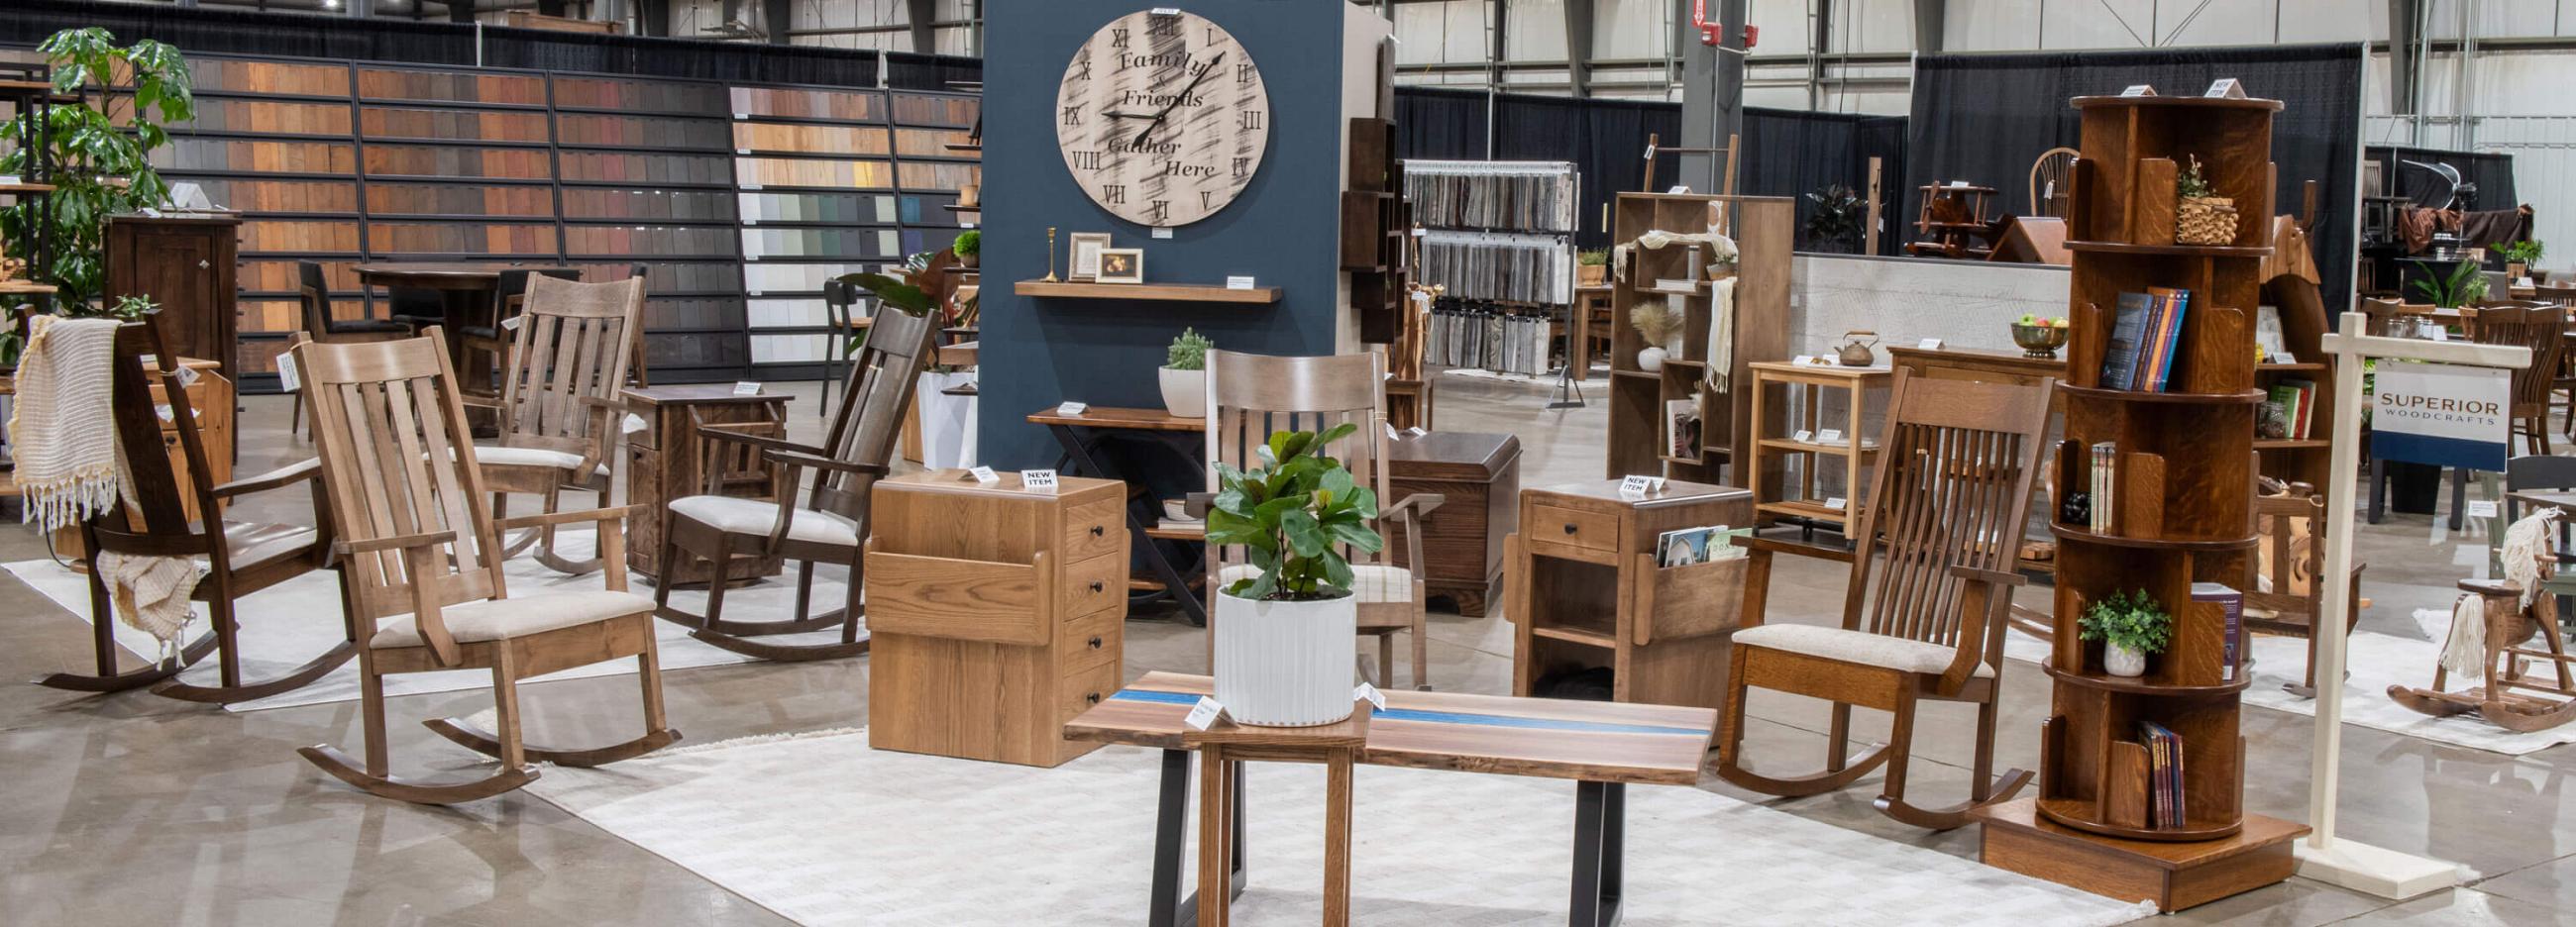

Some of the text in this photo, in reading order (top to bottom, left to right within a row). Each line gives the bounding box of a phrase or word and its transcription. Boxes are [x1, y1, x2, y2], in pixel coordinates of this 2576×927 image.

[1153, 17, 1174, 36] XII
[1112, 29, 1129, 48] XI
[1206, 28, 1213, 47] I
[1081, 61, 1091, 80] X
[1121, 52, 1207, 76] Family
[1236, 64, 1248, 83] II
[1123, 90, 1205, 108] Friends
[1064, 107, 1081, 126] IX
[1242, 111, 1262, 130] III
[1072, 151, 1102, 170] VIII
[1164, 160, 1216, 177] Here
[1232, 157, 1249, 176] IV
[1103, 185, 1127, 205] VII
[1200, 191, 1212, 211] V
[1152, 200, 1169, 220] VI
[2381, 393, 2499, 416] SUPERIOR
[2385, 408, 2495, 426] WOODCRAFTS
